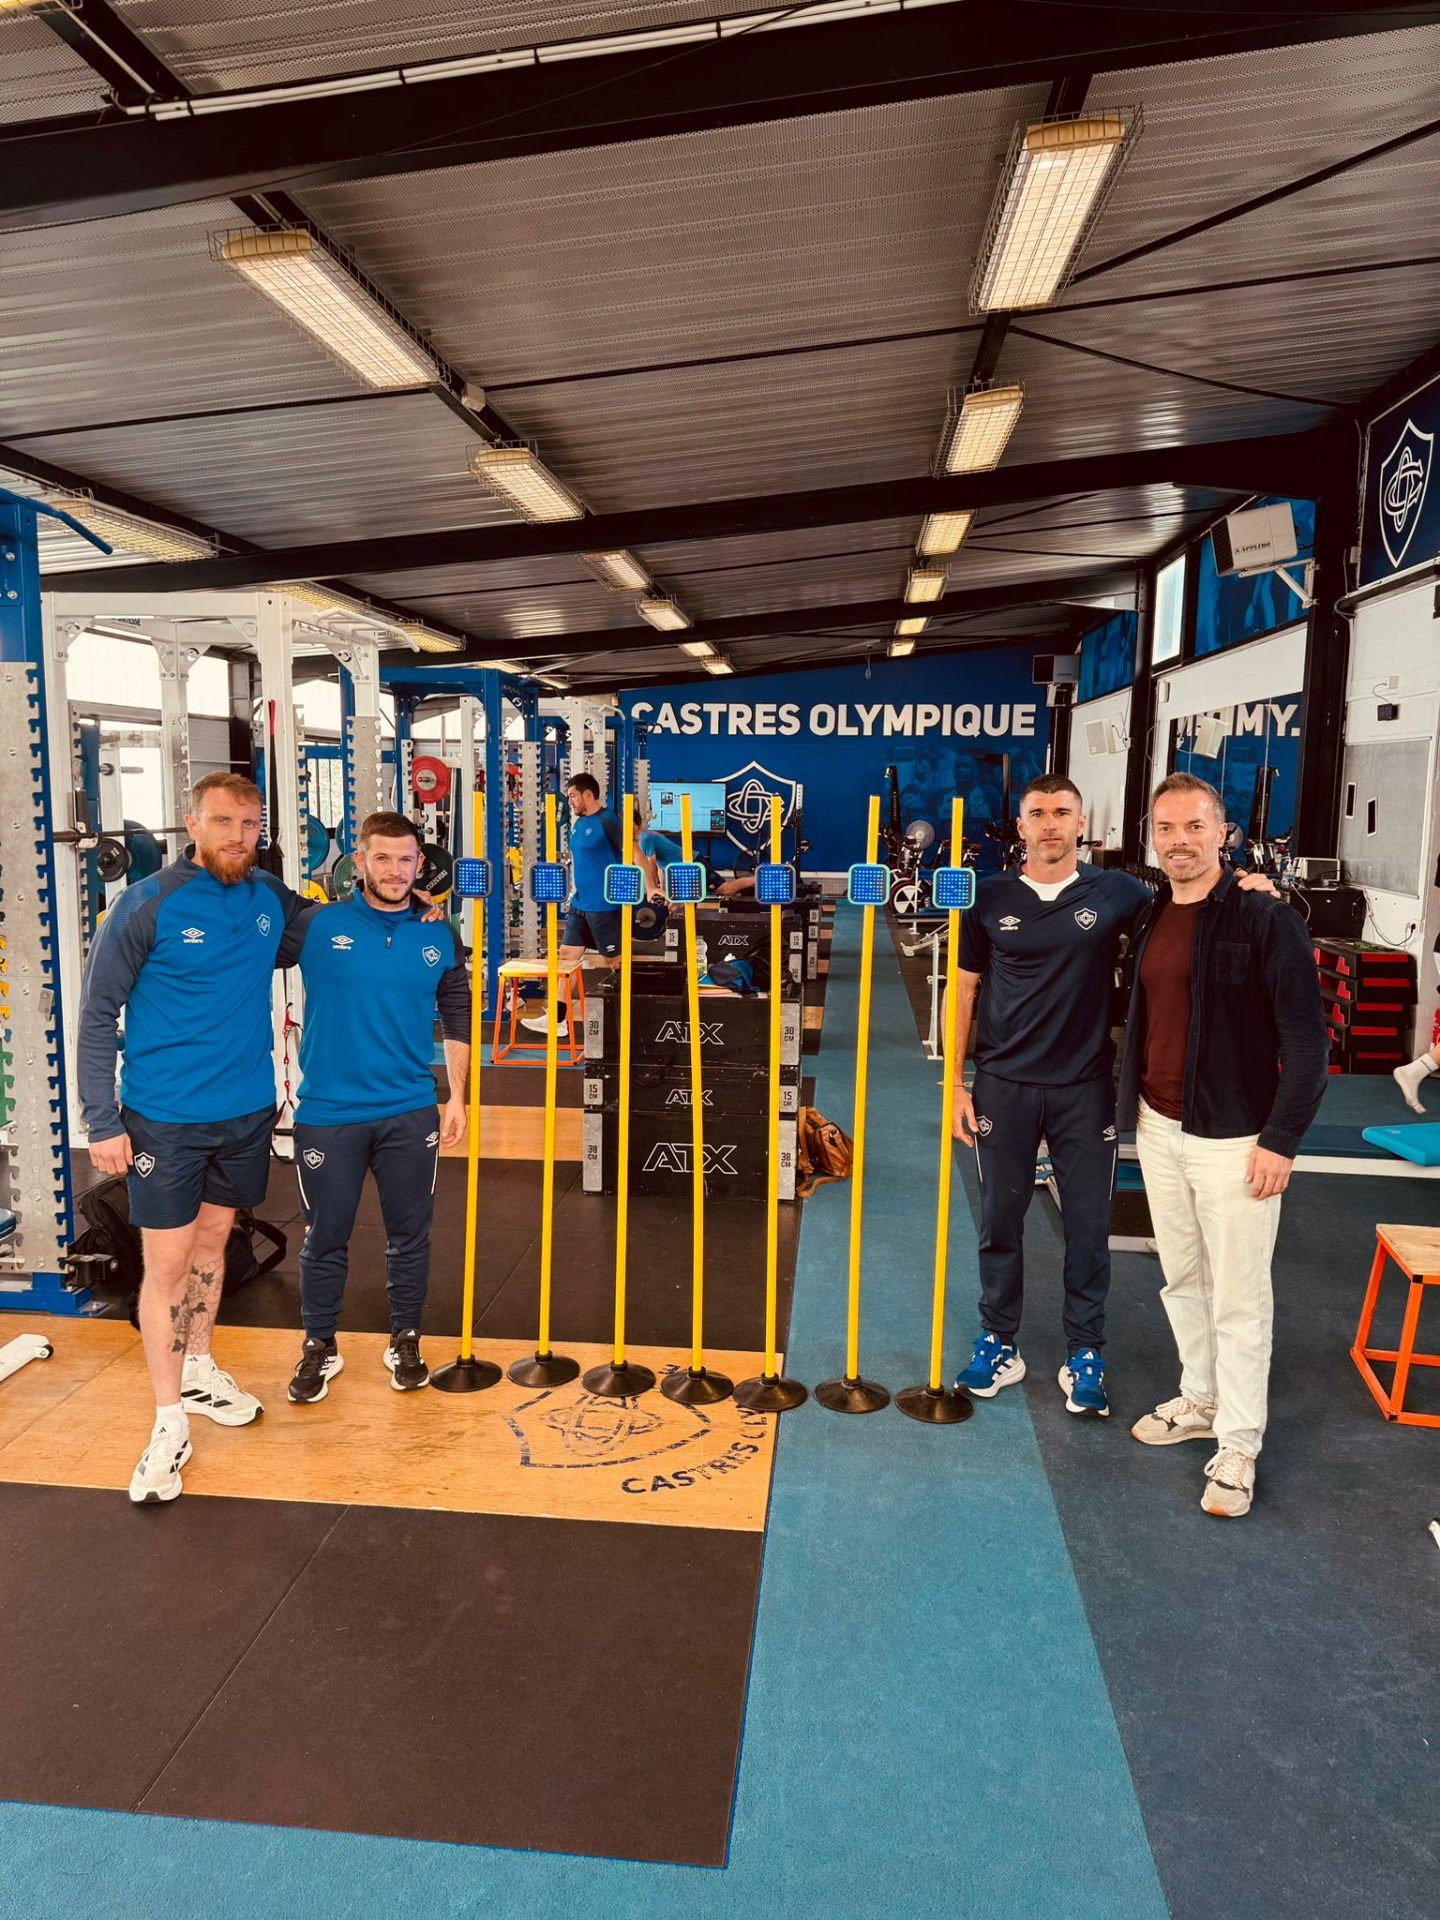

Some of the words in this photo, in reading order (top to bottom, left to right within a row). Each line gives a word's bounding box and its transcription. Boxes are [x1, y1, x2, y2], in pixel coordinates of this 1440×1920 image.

[630, 701, 801, 736] CASTRES
[809, 703, 1037, 738] OLYMPIQUE
[718, 934, 749, 946] ATX
[588, 1020, 599, 1029] 30
[784, 1026, 795, 1035] 30
[589, 1084, 598, 1093] 15
[783, 1091, 792, 1100] 15
[588, 1144, 598, 1153] 38
[780, 1152, 791, 1161] 38
